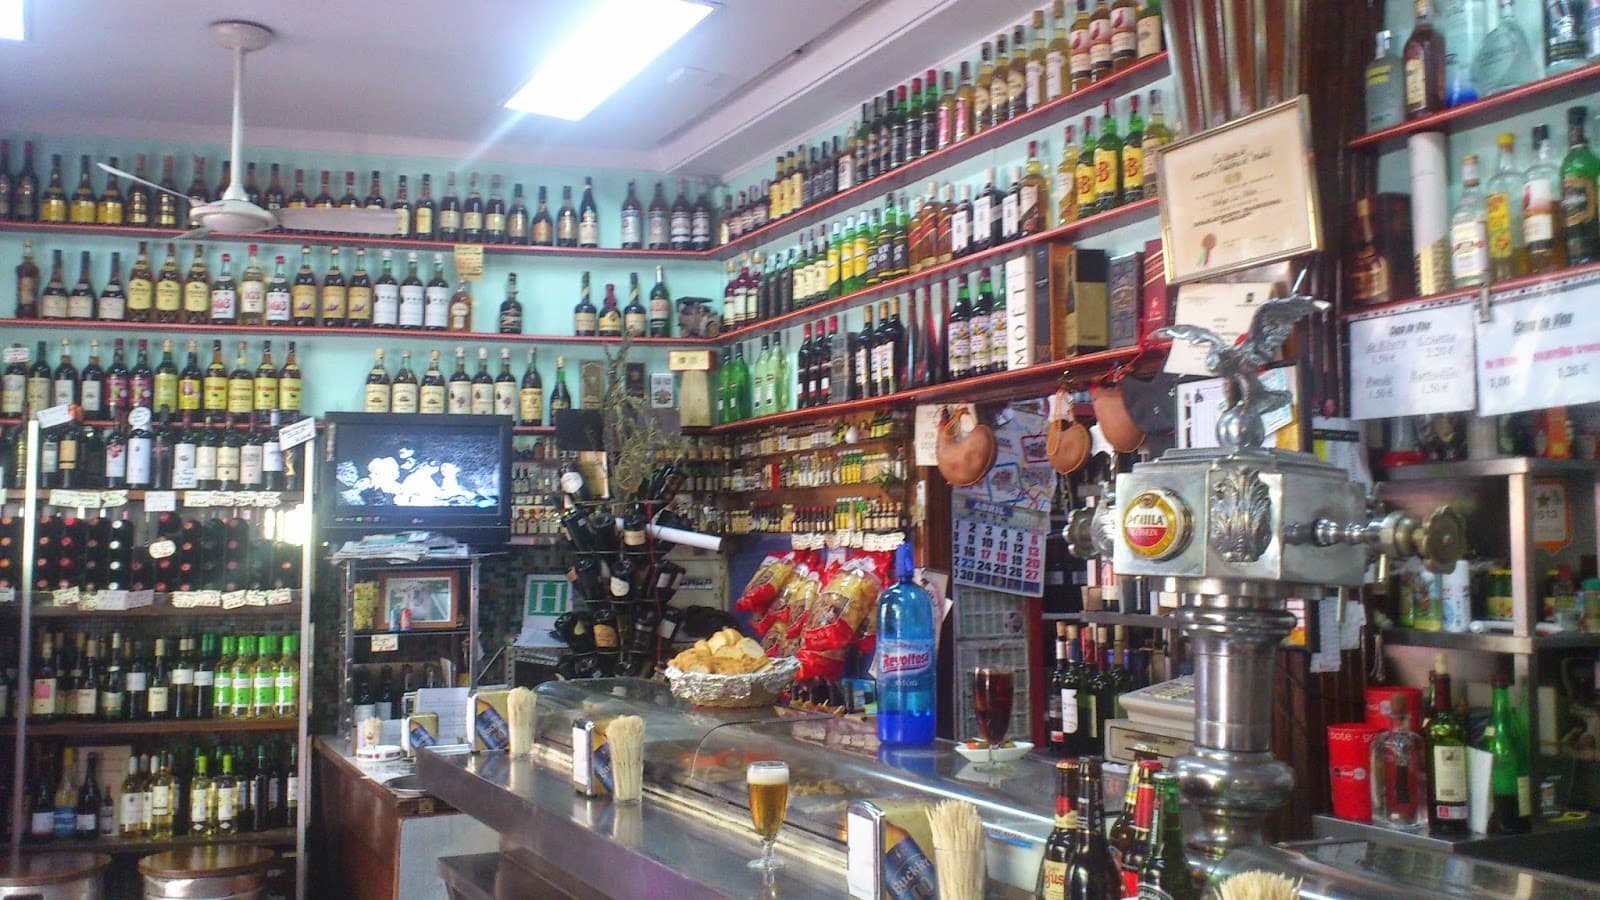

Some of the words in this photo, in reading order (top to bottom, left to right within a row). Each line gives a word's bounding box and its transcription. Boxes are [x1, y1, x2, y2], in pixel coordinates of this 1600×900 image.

[974, 502, 1005, 515] ABRIL
[969, 523, 976, 532] 2
[985, 527, 992, 536] 3
[1001, 529, 1008, 539] 4
[1016, 532, 1023, 542] 5
[968, 535, 975, 544] 9
[982, 538, 992, 548] 10
[999, 541, 1007, 550] 11
[1014, 544, 1023, 554] 12
[964, 547, 975, 557] 16
[981, 550, 991, 559] 17
[997, 552, 1007, 563] 18
[1012, 556, 1022, 565] 19
[1026, 559, 1039, 569] 20
[960, 570, 974, 580] 30
[961, 559, 975, 569] 23
[977, 561, 991, 571] 24
[994, 564, 1007, 574] 25
[1009, 567, 1022, 577] 26
[1026, 570, 1039, 580] 27
[531, 582, 568, 613] H
